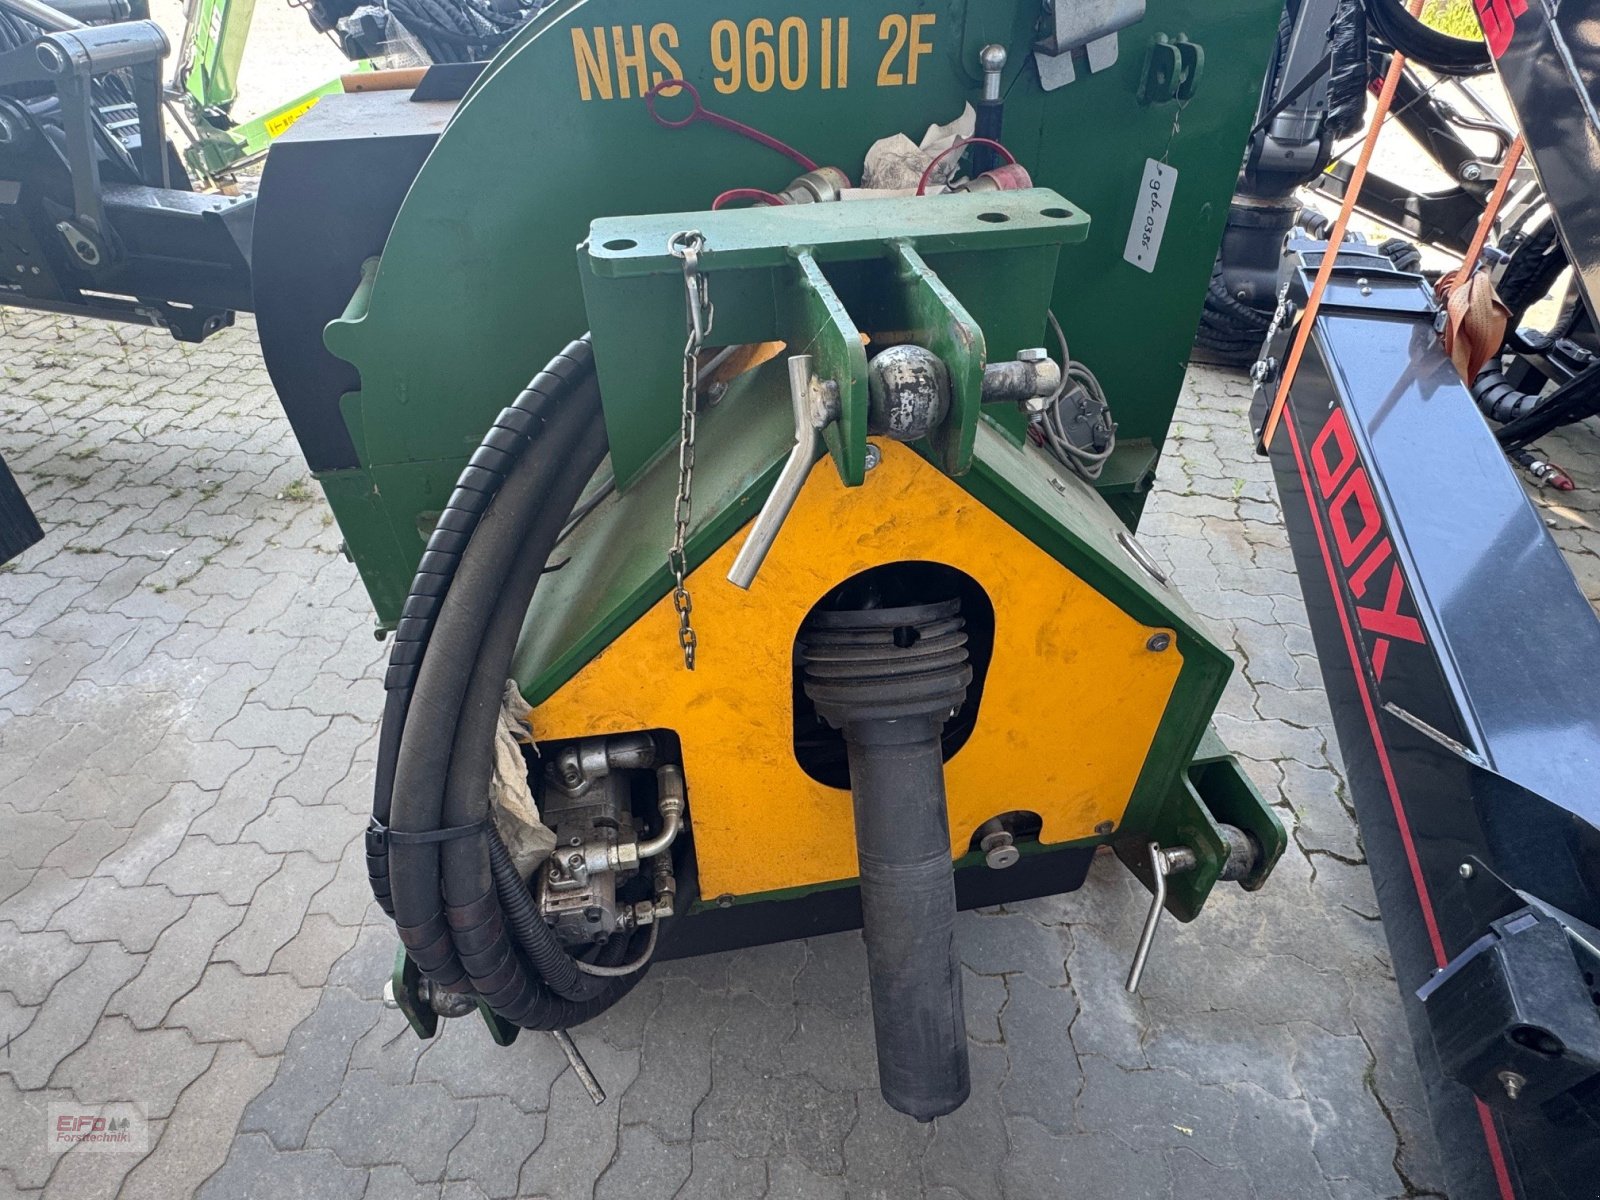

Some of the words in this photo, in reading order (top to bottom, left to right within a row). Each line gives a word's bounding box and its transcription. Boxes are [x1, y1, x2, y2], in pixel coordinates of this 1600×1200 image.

[571, 22, 684, 101] NHS
[876, 13, 936, 87] 2F
[1310, 406, 1426, 683] X100
